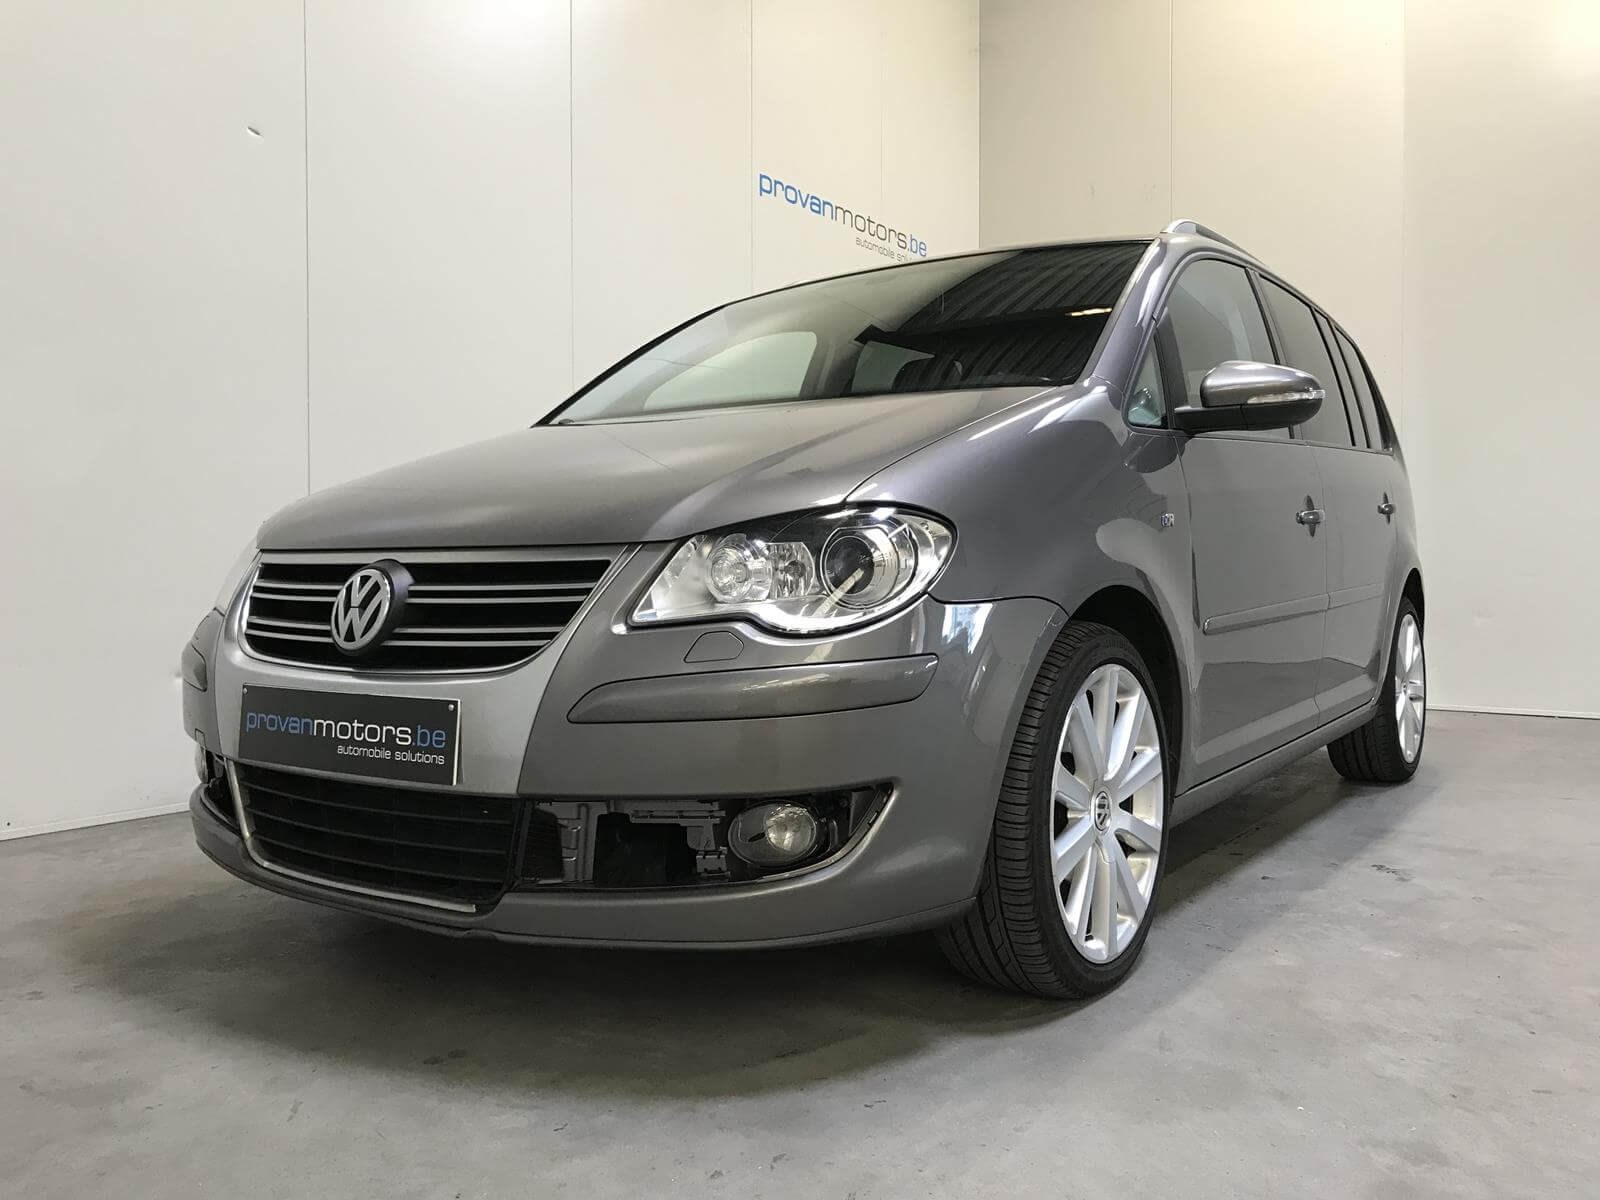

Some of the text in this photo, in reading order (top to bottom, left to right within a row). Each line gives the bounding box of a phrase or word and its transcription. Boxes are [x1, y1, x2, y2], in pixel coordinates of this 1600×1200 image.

[759, 173, 927, 257] provanmotors.be
[855, 237, 895, 259] automobile
[246, 711, 447, 749] provanmotors.be
[337, 745, 445, 765] automobile solutions
